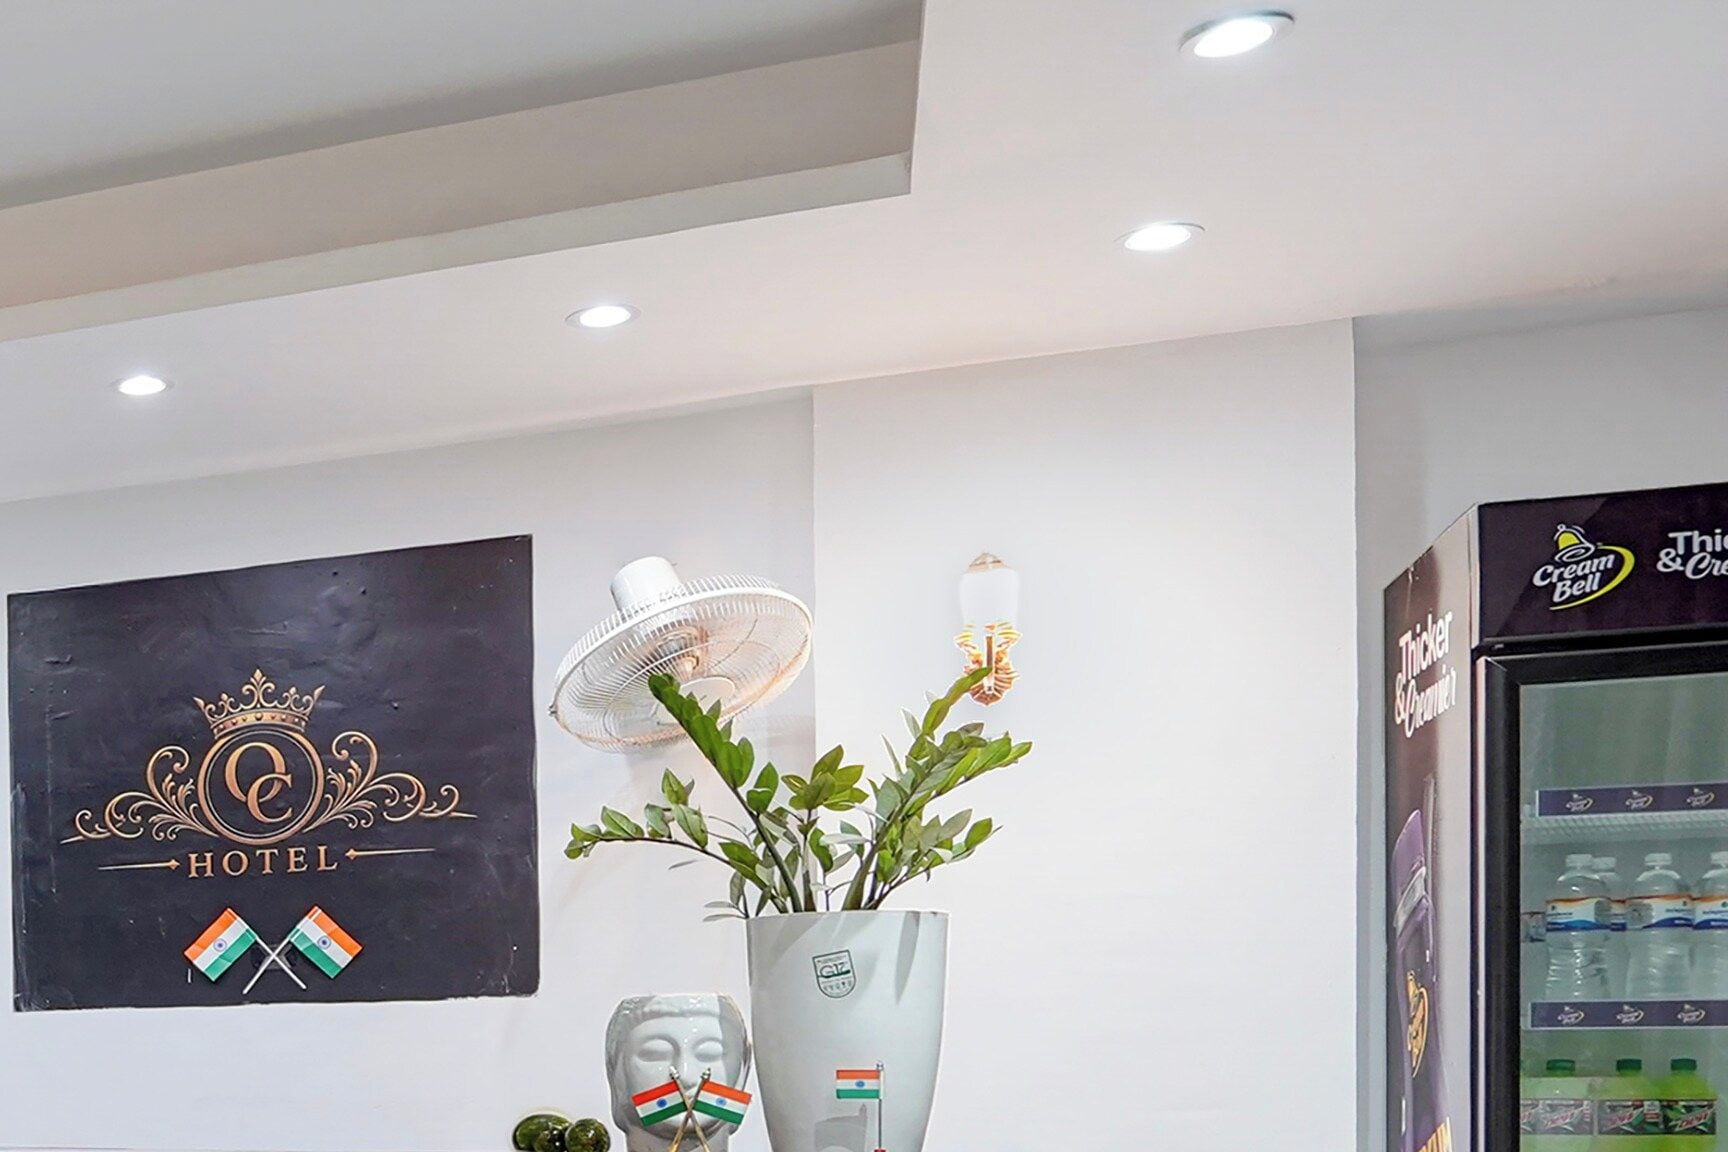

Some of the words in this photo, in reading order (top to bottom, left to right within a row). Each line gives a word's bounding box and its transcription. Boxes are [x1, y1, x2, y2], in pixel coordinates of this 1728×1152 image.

[1532, 554, 1615, 587] Cream
[1552, 572, 1601, 603] Bell
[1399, 611, 1453, 684] Thicker
[188, 845, 338, 878] HOTEL
